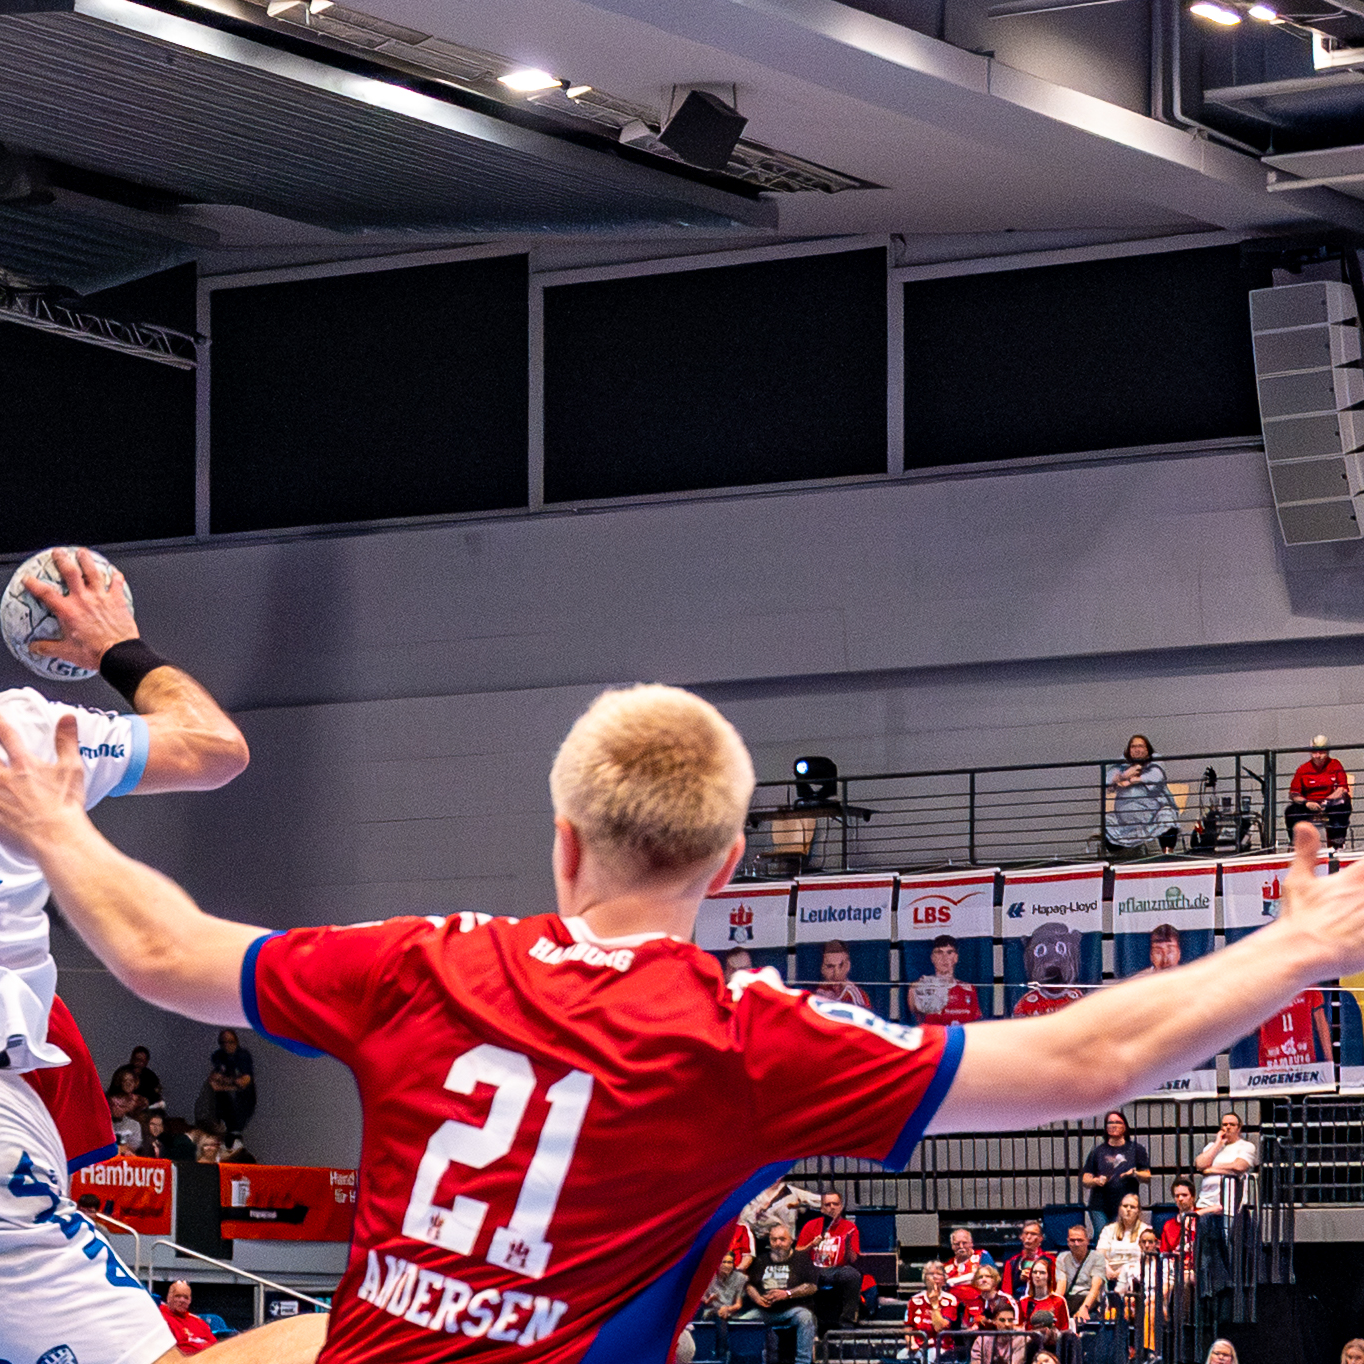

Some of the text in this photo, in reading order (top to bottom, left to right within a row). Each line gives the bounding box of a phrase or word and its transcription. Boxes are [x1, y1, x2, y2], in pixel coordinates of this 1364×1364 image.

[1032, 900, 1098, 916] Hapag-Lloyd
[1119, 893, 1210, 914] pflanzmich.de
[800, 905, 883, 925] Leukotape
[913, 906, 952, 924] LBS
[401, 1043, 594, 1279] 21
[80, 1160, 166, 1194] Hamburg
[357, 1250, 568, 1347] ANDERSEN
